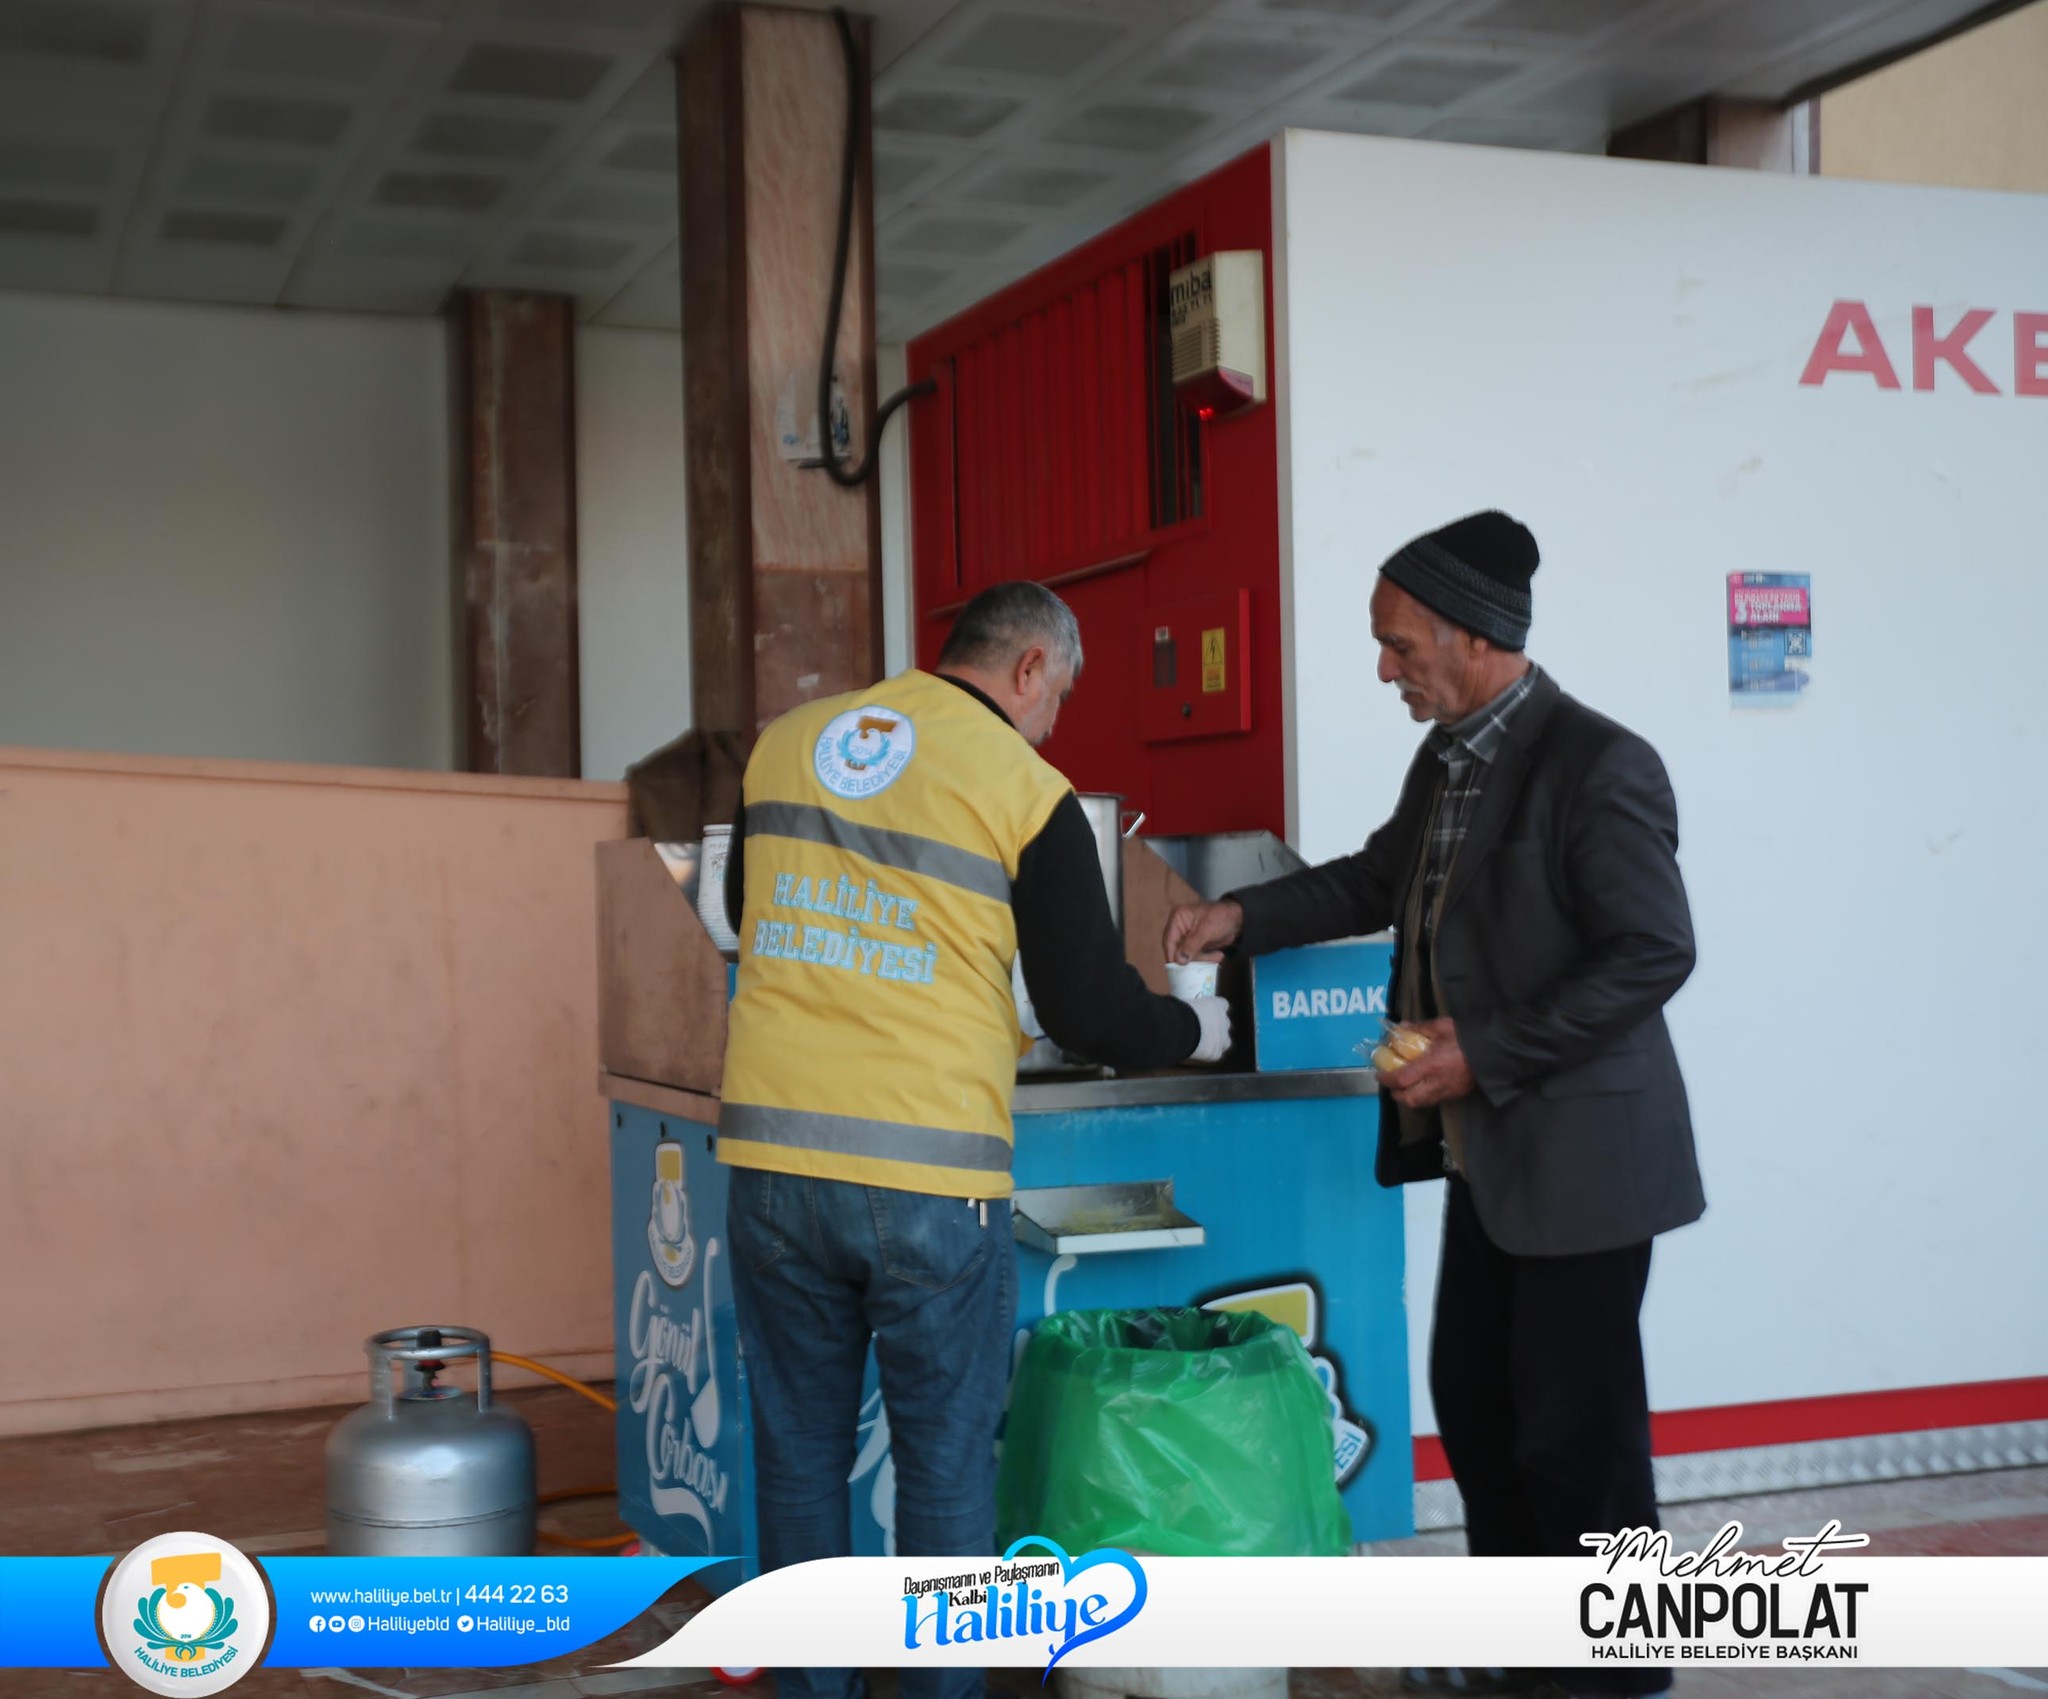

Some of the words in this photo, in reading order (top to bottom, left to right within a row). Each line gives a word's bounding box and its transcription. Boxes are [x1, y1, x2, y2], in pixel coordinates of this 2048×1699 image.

[772, 872, 918, 932] HALİLİYE
[752, 920, 938, 984] BELEDİYESİ
[1272, 985, 1386, 1019] BARDAK
